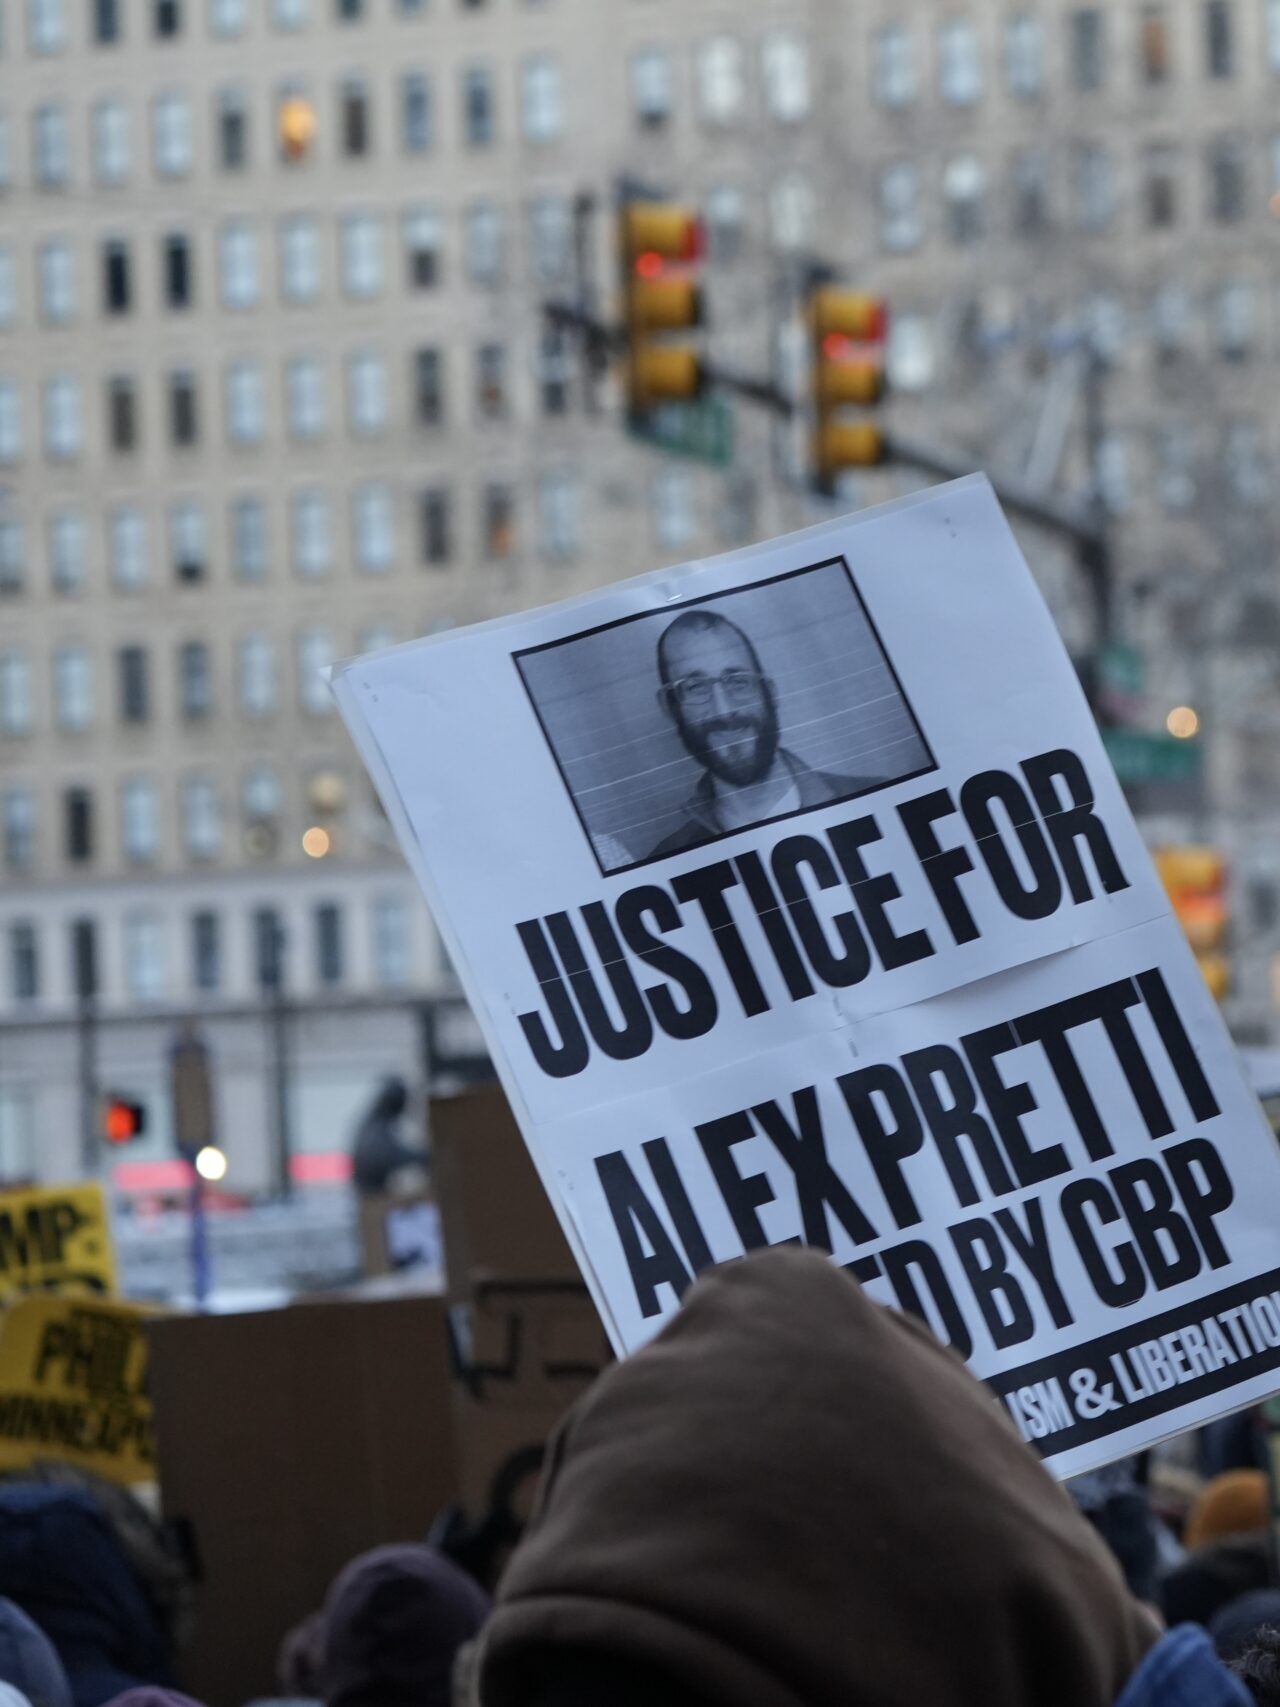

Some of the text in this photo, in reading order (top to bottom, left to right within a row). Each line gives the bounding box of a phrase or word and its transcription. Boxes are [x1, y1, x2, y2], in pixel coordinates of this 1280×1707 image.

[515, 748, 1132, 1079] JUSTICE FOR
[593, 1086, 880, 1319] ALEX
[836, 967, 1221, 1229] PRETTI
[945, 1197, 1075, 1350] BY
[1060, 1137, 1235, 1309] CBP
[1005, 1377, 1076, 1443] ISM
[1069, 1367, 1124, 1420] &
